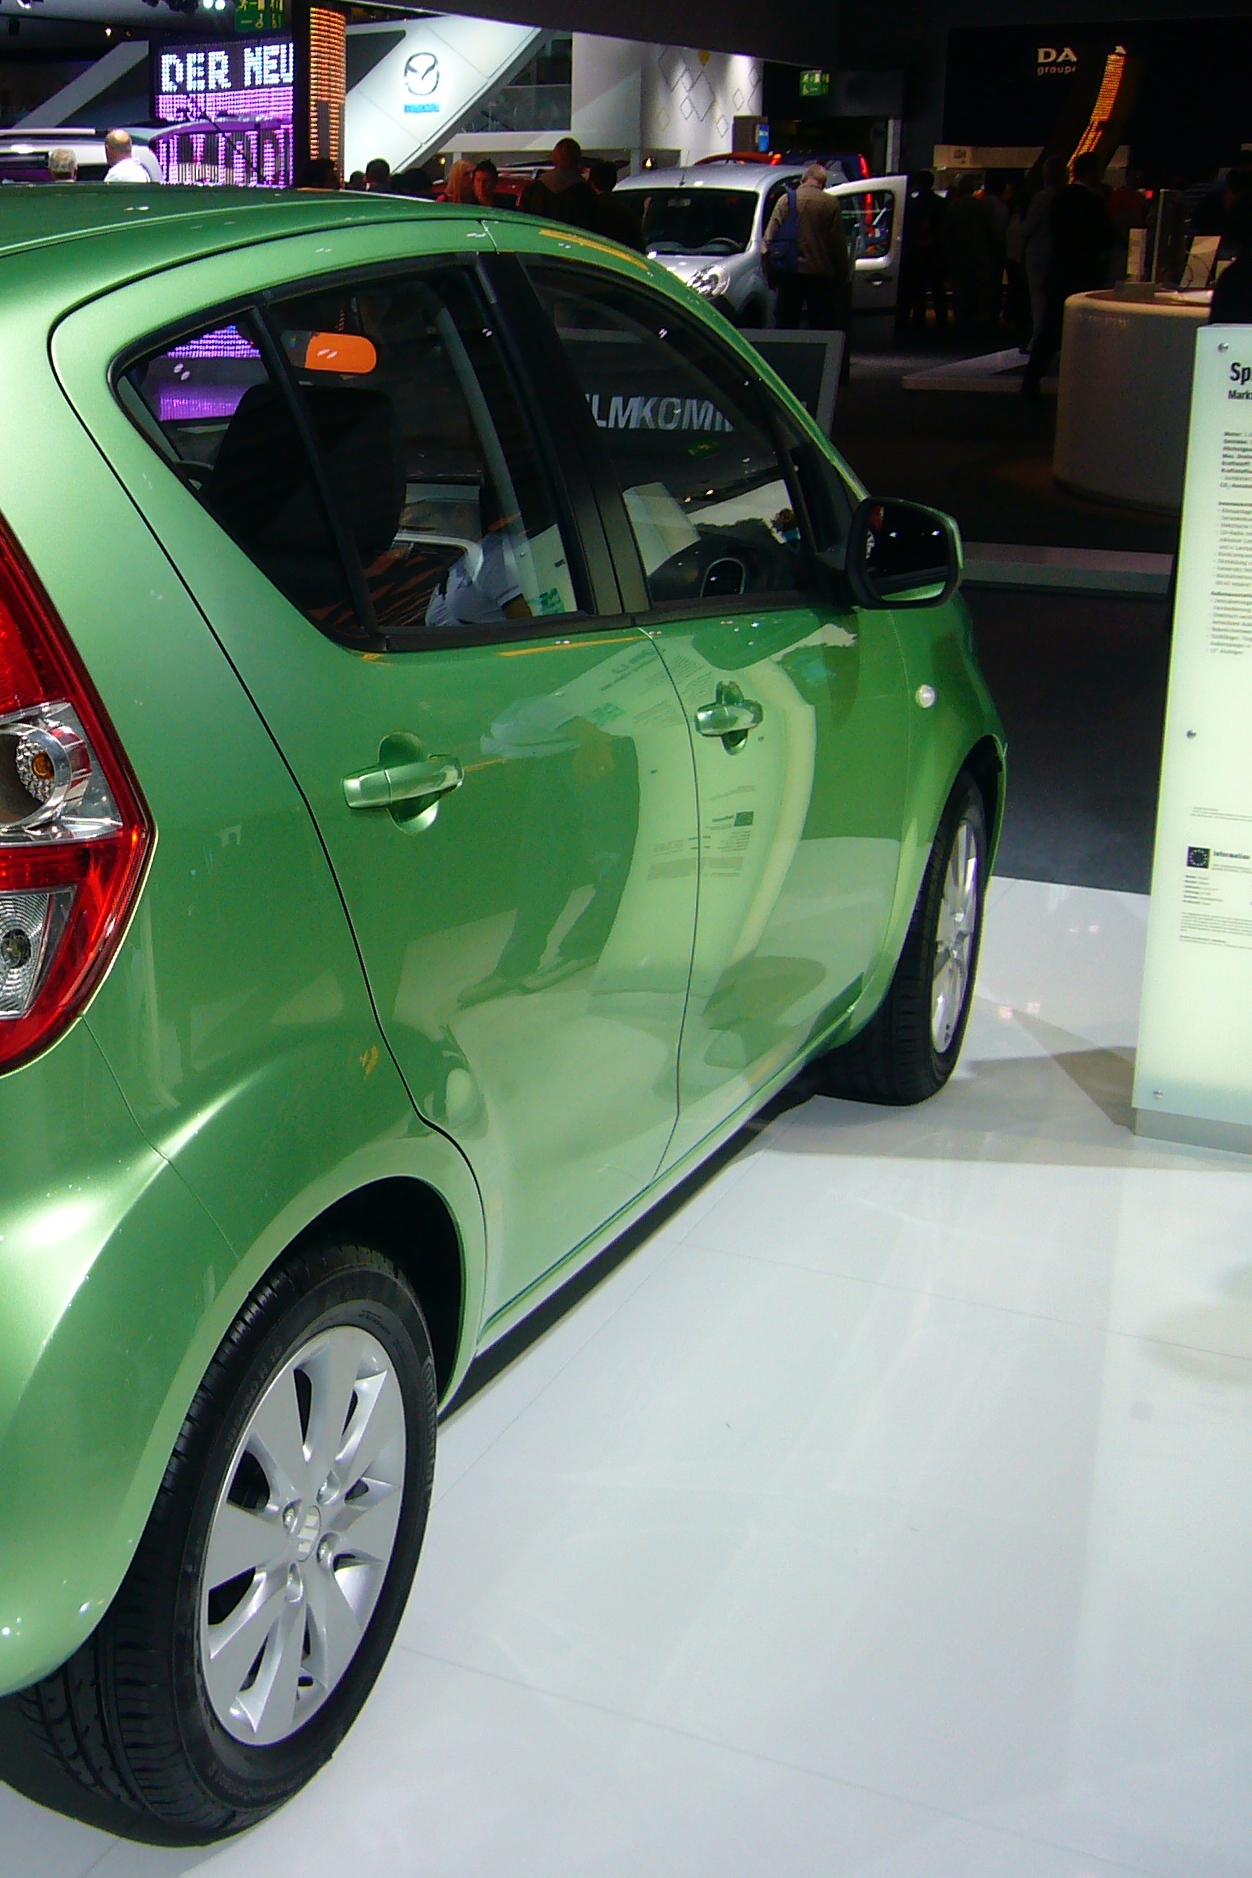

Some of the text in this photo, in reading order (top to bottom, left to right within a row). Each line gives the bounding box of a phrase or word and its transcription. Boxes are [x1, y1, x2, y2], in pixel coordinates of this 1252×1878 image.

[1037, 47, 1077, 63] DA
[161, 51, 232, 93] DER
[1037, 65, 1076, 76] group
[1230, 361, 1252, 385] Sp
[1228, 389, 1252, 400] Mark
[585, 393, 734, 432] LMKOM
